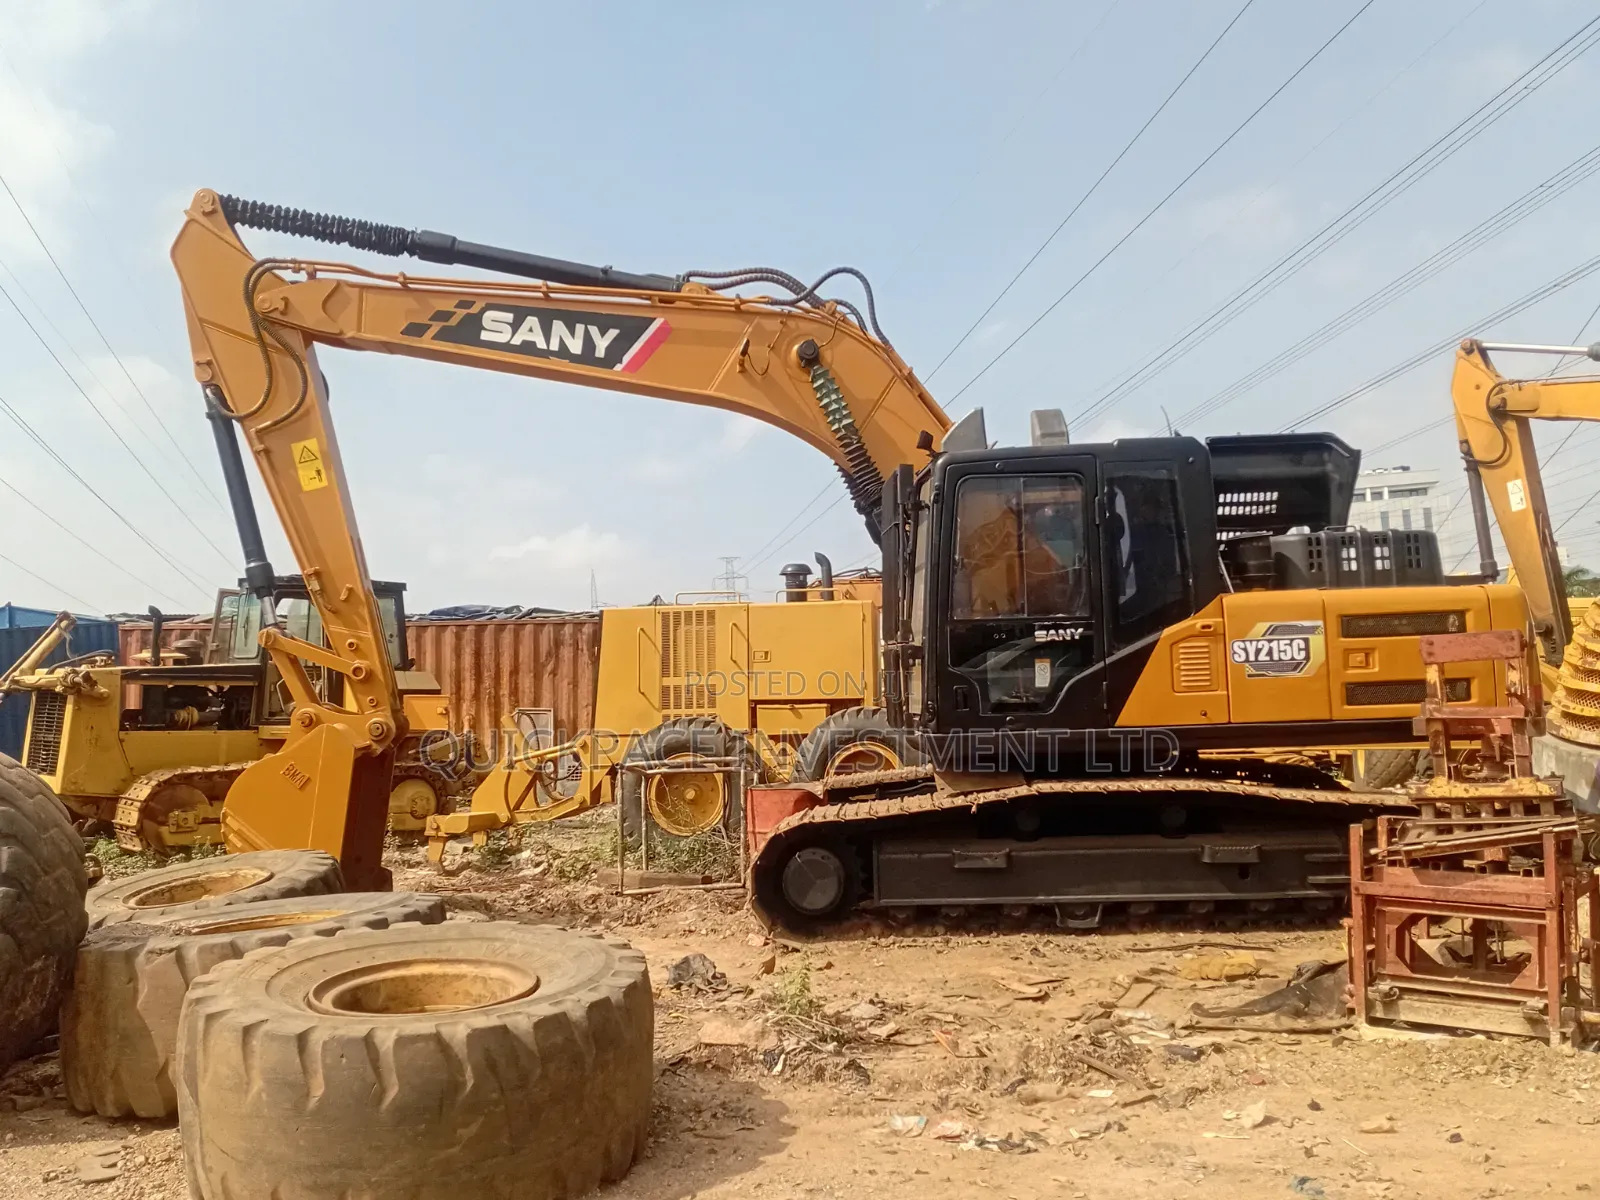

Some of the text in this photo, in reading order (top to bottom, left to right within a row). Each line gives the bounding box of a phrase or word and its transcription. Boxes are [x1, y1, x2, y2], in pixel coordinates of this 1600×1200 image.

[480, 310, 620, 359] SANY
[1034, 627, 1084, 642] SANY
[1232, 638, 1306, 662] SY215C
